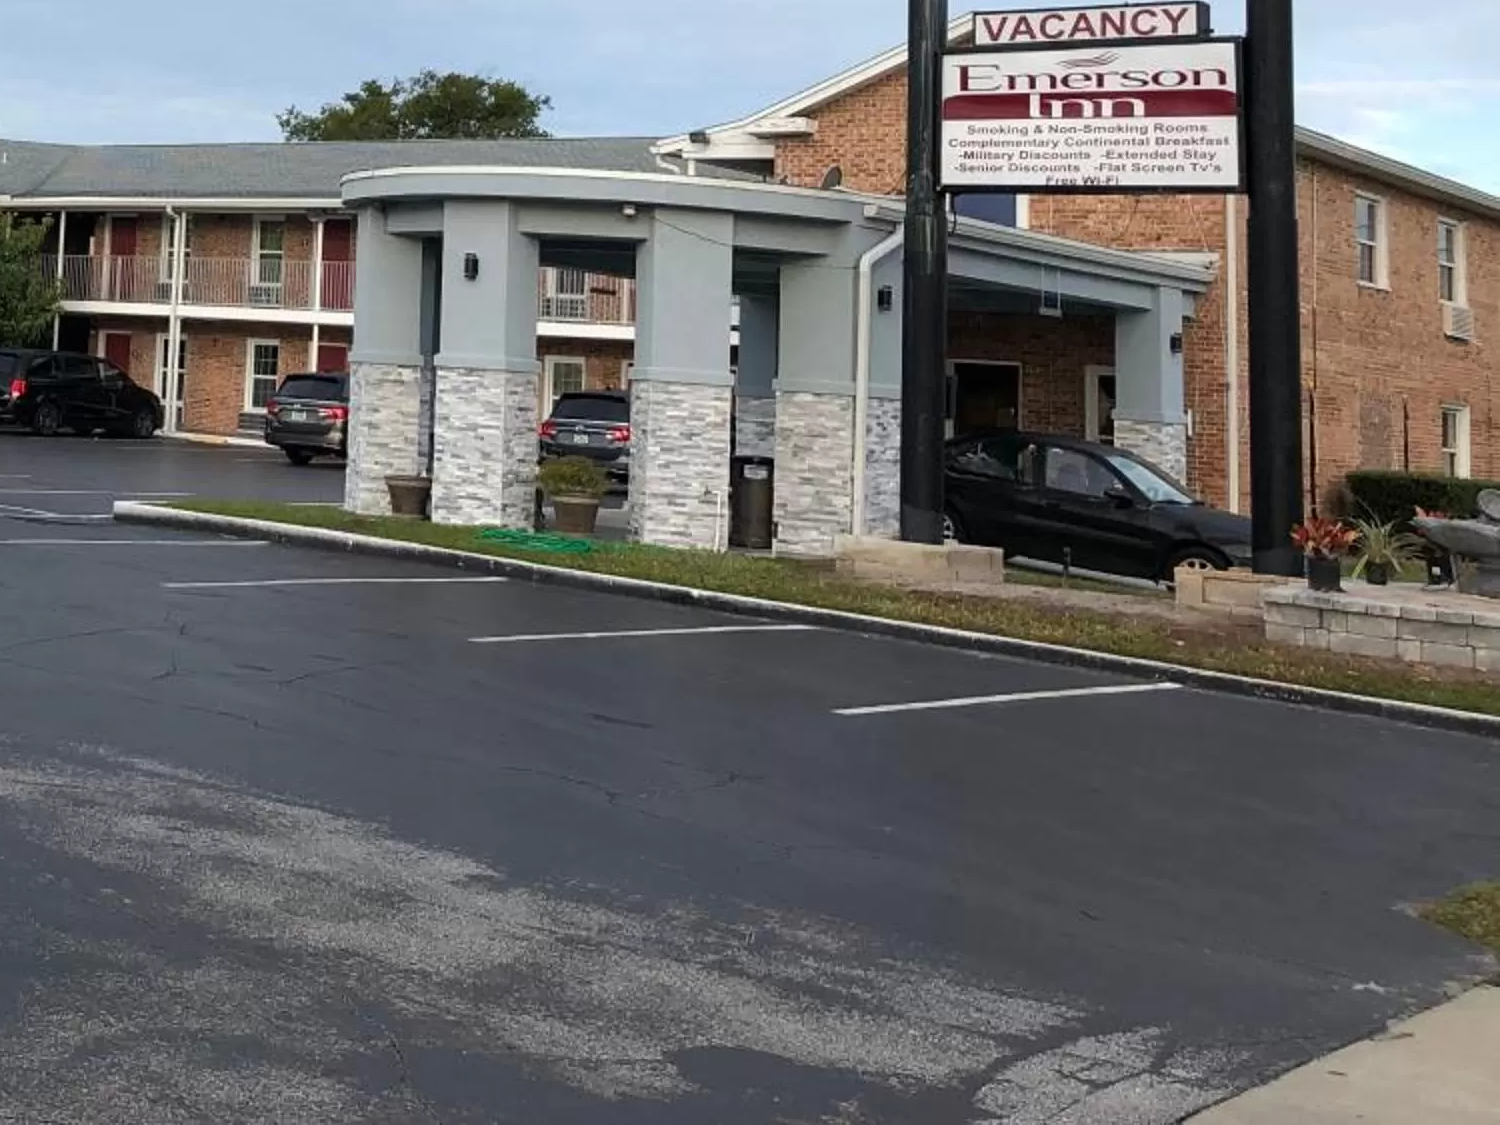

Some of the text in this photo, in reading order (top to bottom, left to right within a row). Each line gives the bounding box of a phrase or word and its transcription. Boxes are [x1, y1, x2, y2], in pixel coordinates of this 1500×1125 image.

[982, 7, 1190, 42] VACANCY
[952, 64, 1228, 92] Emerson
[1029, 91, 1146, 118] Inn
[967, 123, 1209, 136] Smoking & Non-Smoking Rooms
[948, 136, 1230, 148] Complementary Continental Breakfast
[959, 149, 1217, 161] -Military Discounts -Extended Stay
[954, 163, 1004, 173] -Senior
[1008, 163, 1081, 173] Discounts
[1094, 163, 1127, 172] -Flat
[1131, 163, 1185, 172] Screen
[1045, 175, 1078, 185] Free
